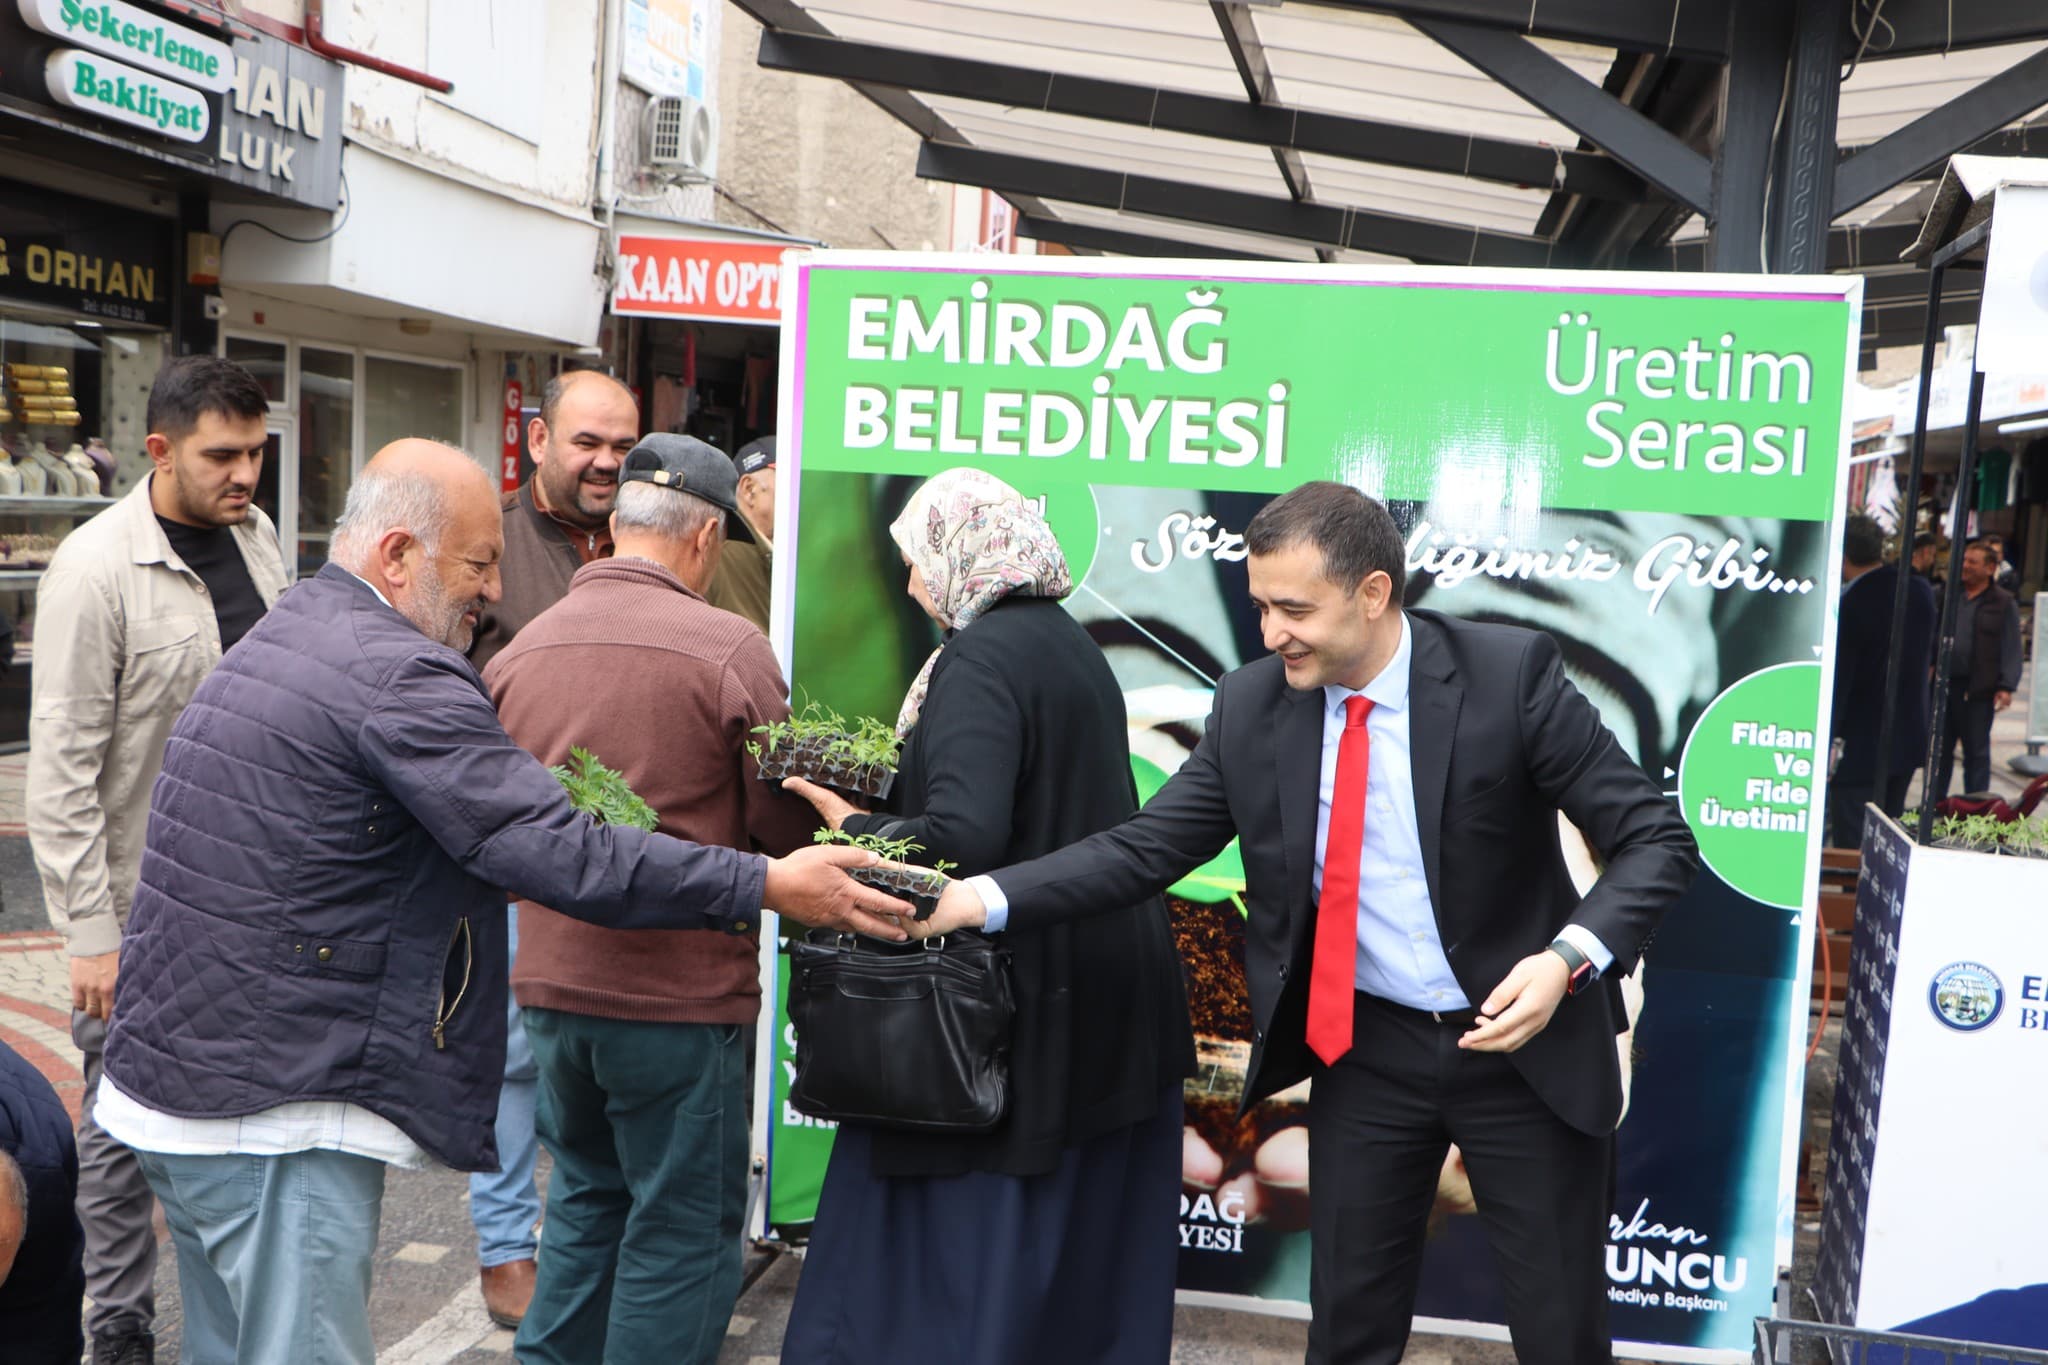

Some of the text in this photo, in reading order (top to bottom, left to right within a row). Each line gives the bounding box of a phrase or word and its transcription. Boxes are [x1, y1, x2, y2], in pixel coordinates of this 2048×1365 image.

[60, 0, 219, 77] Şekerleme
[73, 61, 203, 132] Bakliyat
[26, 243, 155, 302] ORHAN
[617, 254, 710, 304] KAAN
[847, 278, 1227, 374] EMİRDAĞ
[1544, 312, 1812, 404] Üretim
[843, 375, 1289, 469] BELEDİYESİ
[1581, 402, 1807, 477] Serası
[1731, 721, 1813, 750] Fidan
[1773, 751, 1812, 777] Ve
[1700, 796, 1808, 833] Üretimi
[1745, 777, 1810, 805] Fide
[1178, 1222, 1245, 1252] YESİ
[1604, 1244, 1749, 1293] UNCU
[1663, 1290, 1729, 1312] Başkanı
